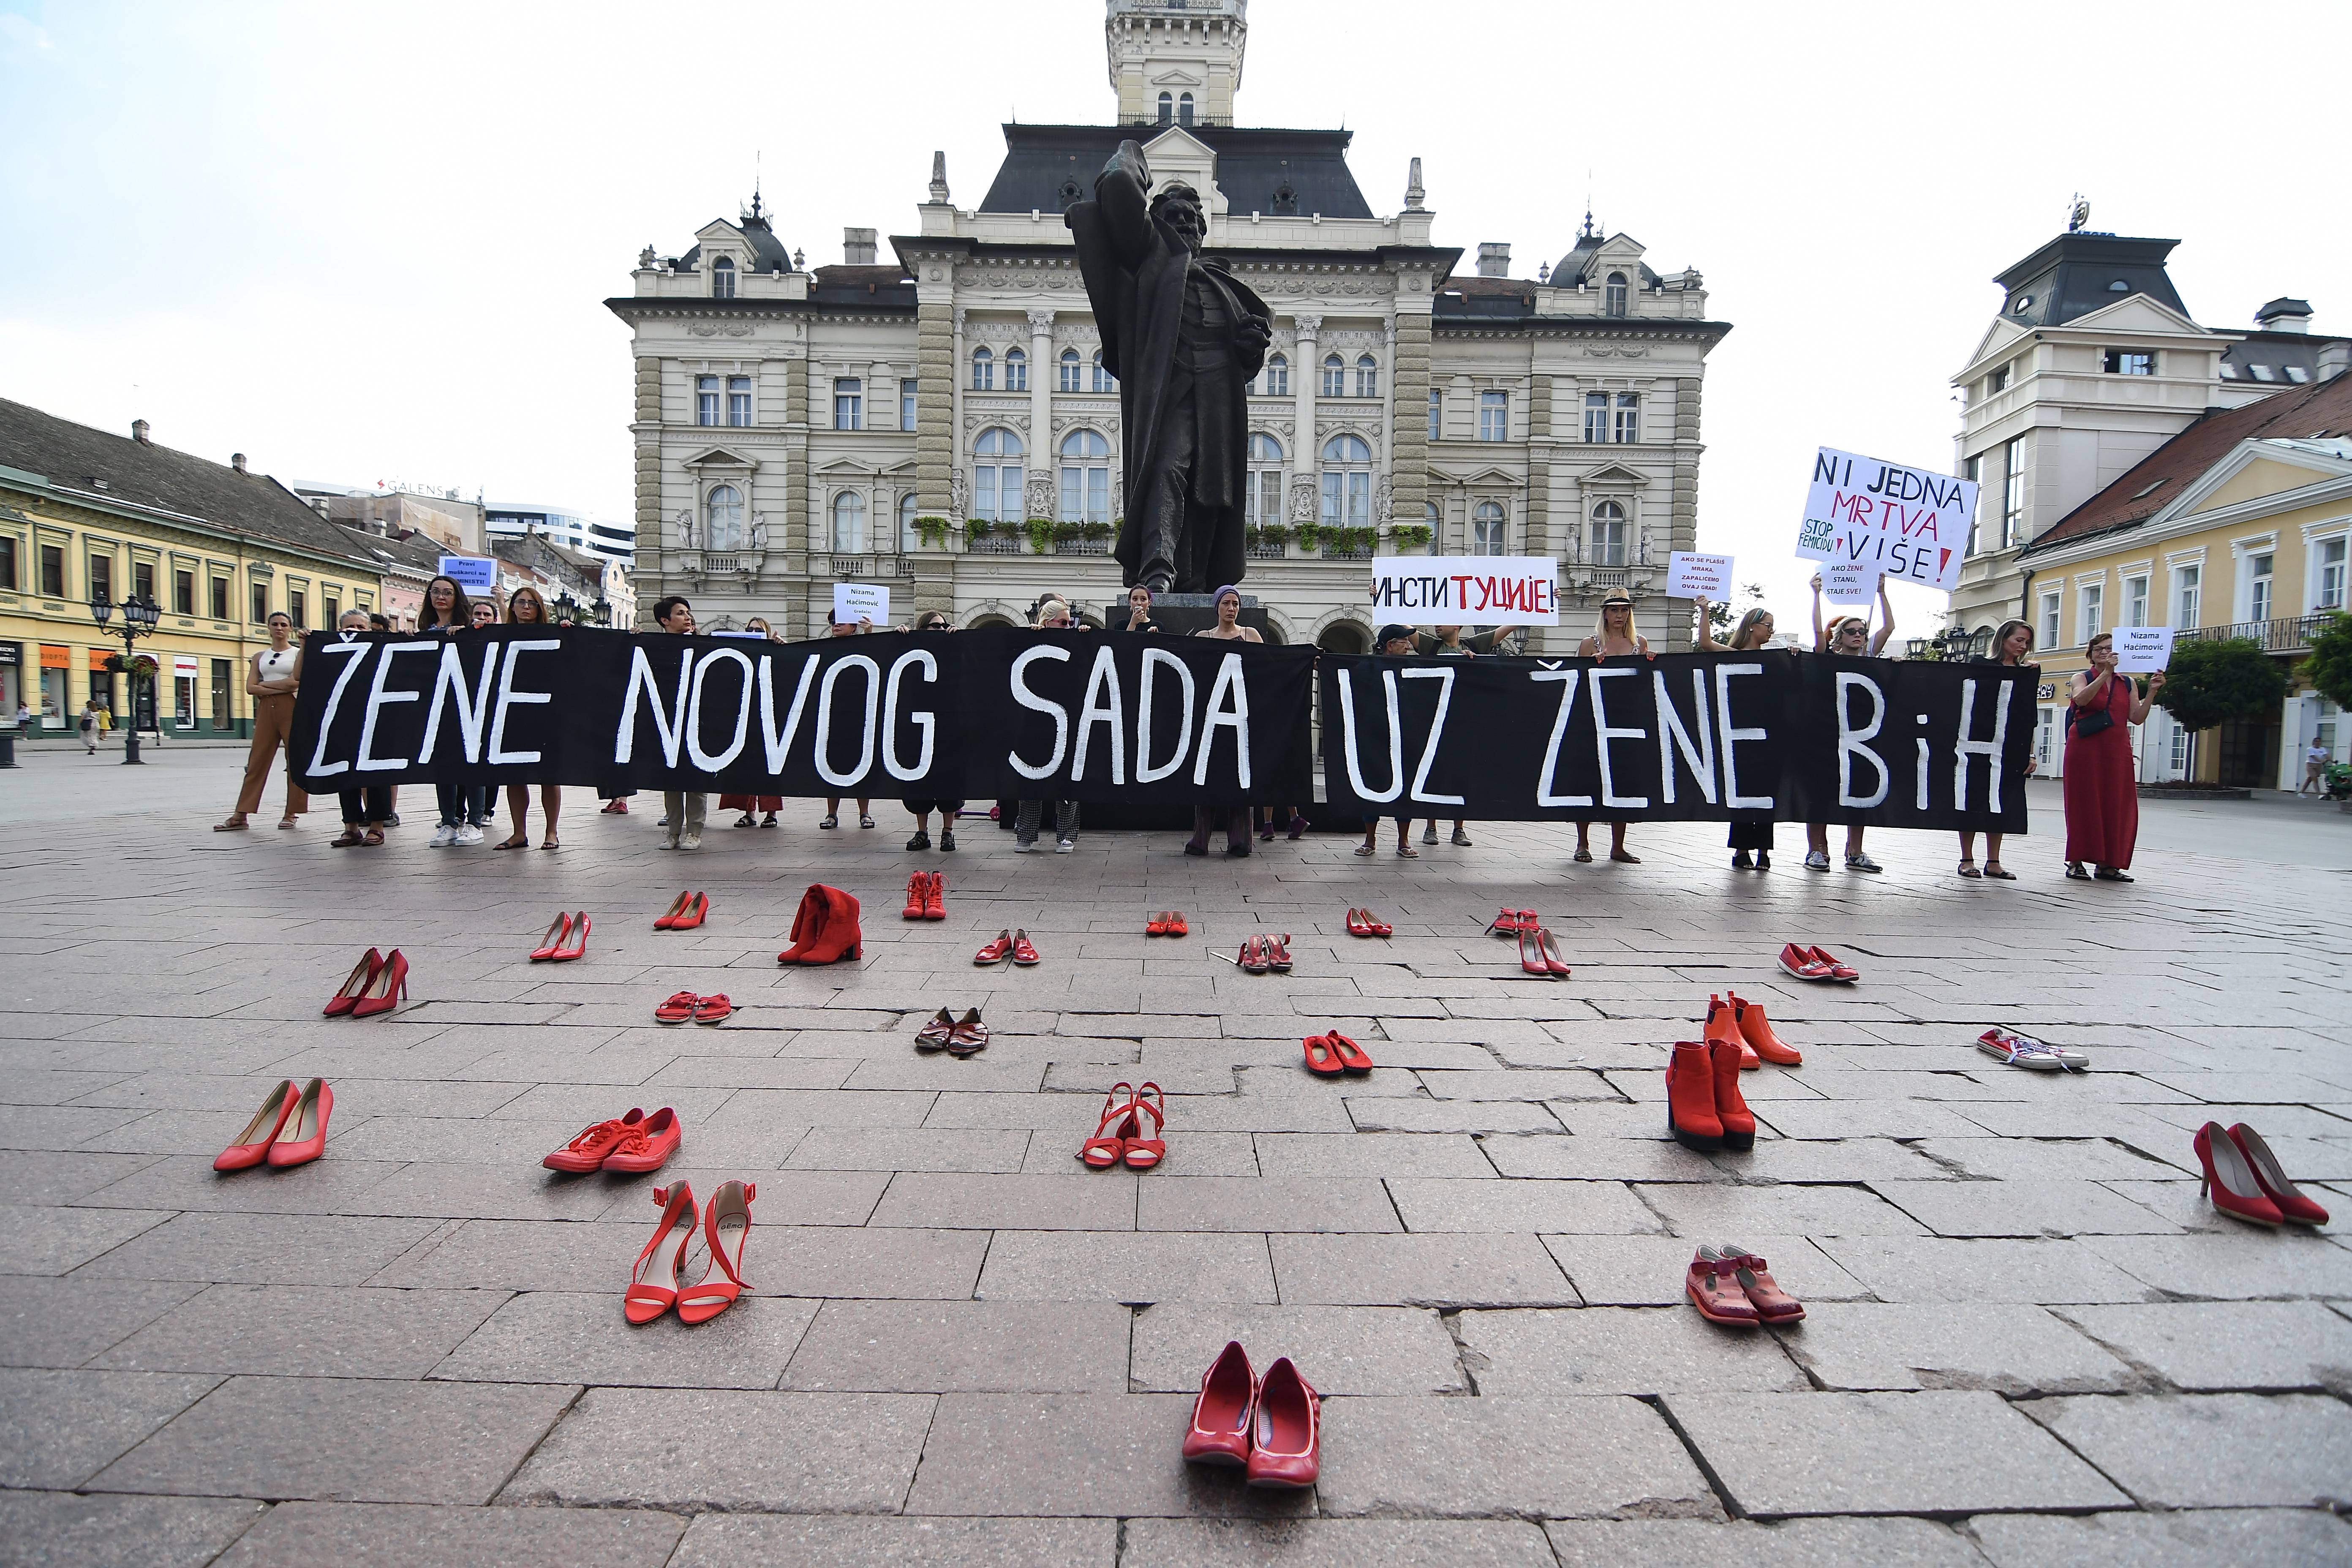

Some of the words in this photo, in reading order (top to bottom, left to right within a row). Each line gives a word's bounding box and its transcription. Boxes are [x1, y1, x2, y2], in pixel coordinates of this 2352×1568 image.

[388, 481, 443, 496] GALENS
[1814, 452, 1852, 487] NI
[1867, 466, 1964, 514] JEDNA
[1805, 519, 1833, 537] STOP
[1831, 490, 1938, 542] MRTVA
[1848, 531, 1952, 583] VIŠE!
[305, 632, 561, 776] ŽENE
[615, 646, 937, 787] NOVOG
[1009, 644, 1250, 789] SADA
[1337, 667, 1465, 806] UZ
[1529, 659, 1774, 808] ŽENE
[1836, 672, 2013, 813] BiH
